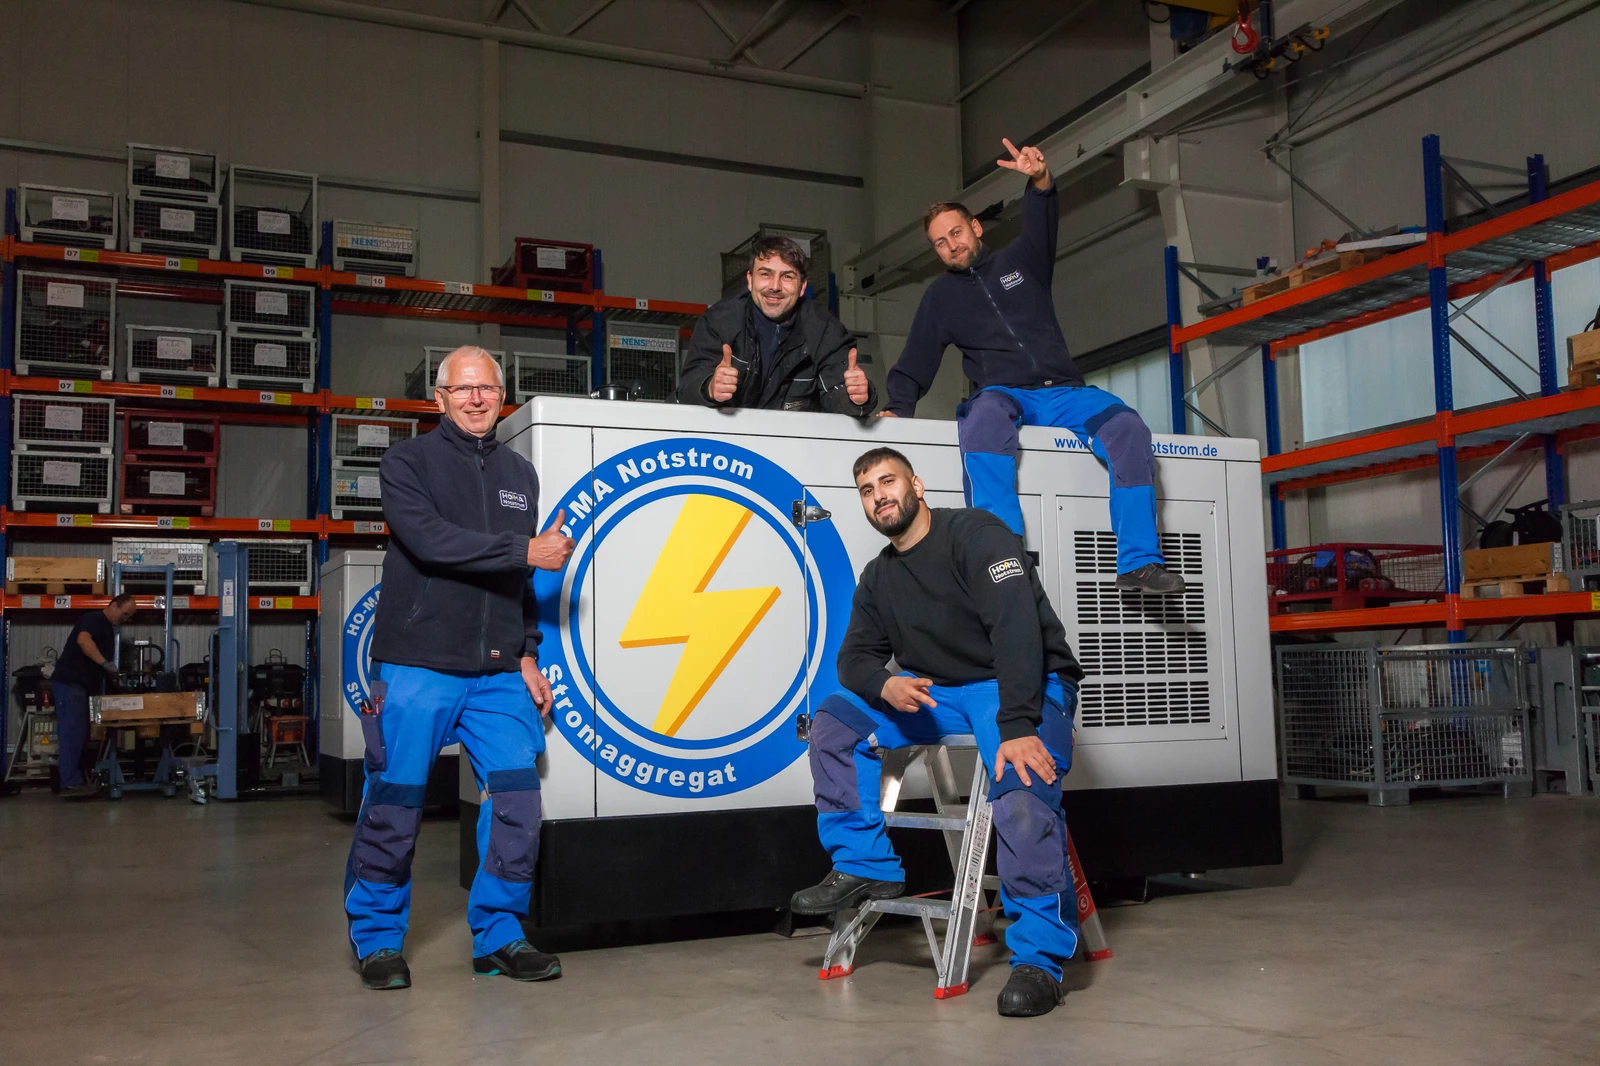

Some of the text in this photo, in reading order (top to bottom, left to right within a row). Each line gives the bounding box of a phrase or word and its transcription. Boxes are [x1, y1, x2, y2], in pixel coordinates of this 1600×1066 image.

[351, 237, 413, 250] NENSPOWER
[66, 249, 79, 257] 07
[621, 337, 675, 349] NENSPOWER
[616, 447, 754, 484] Notstrom
[994, 568, 1022, 580] Notstrom
[541, 663, 737, 793] Stromaggregat
